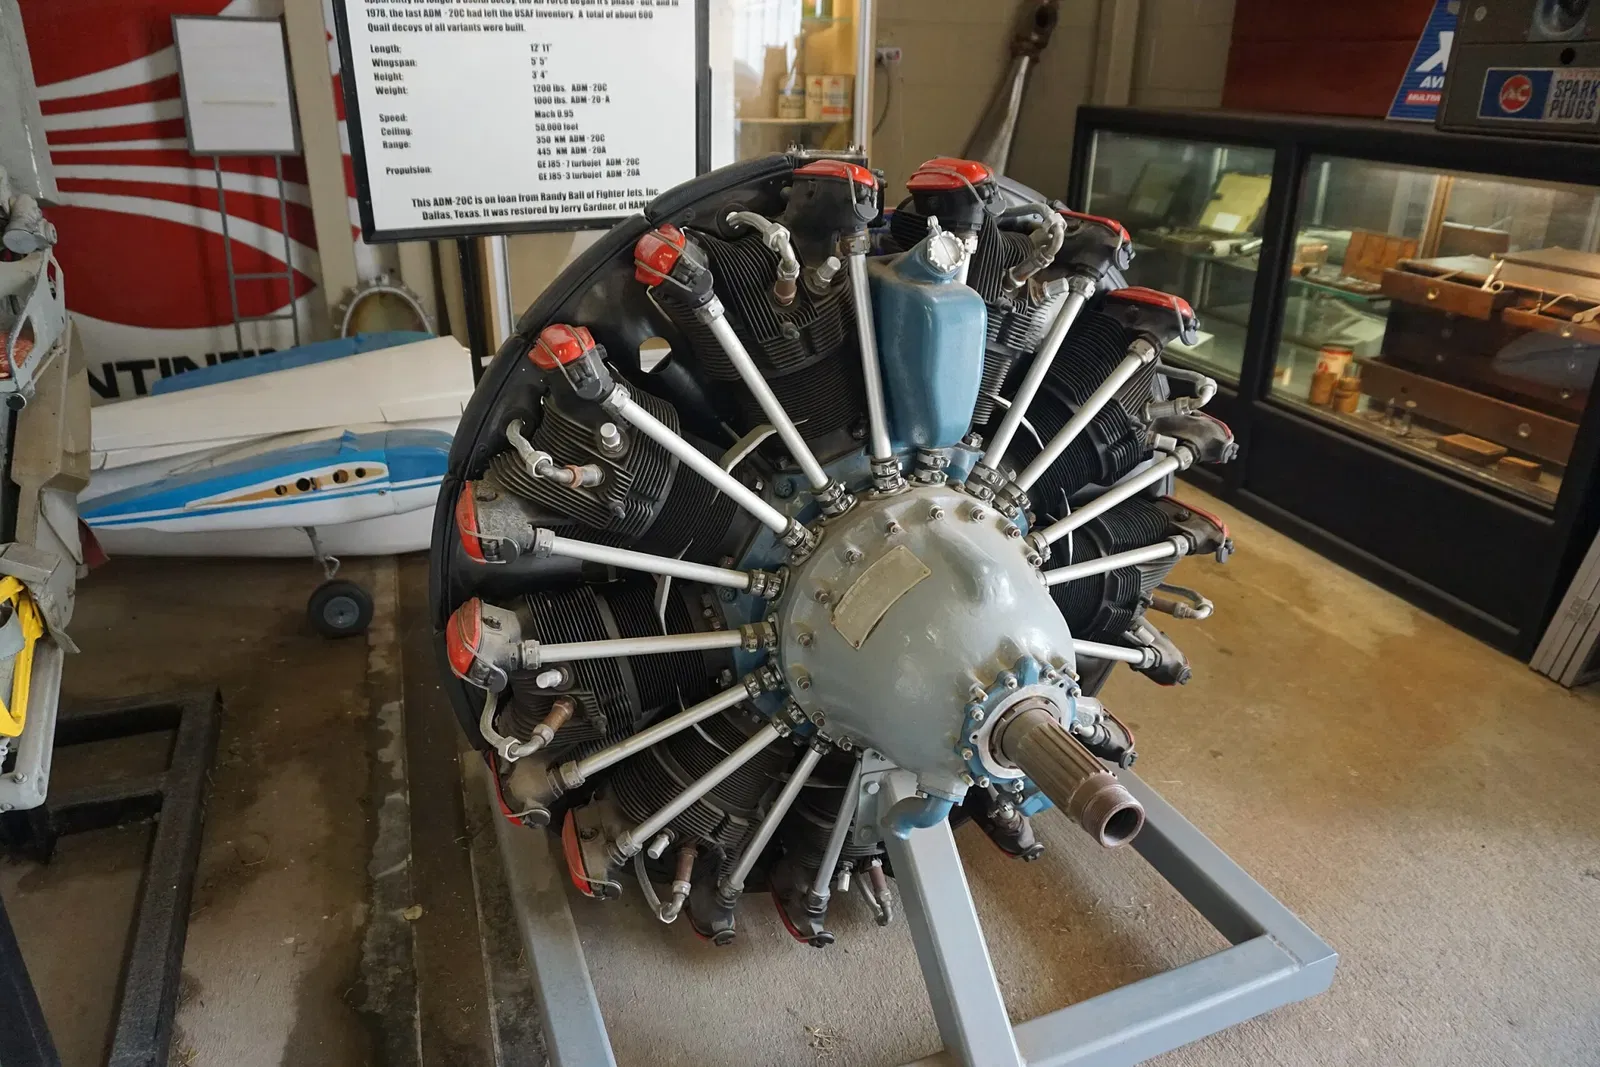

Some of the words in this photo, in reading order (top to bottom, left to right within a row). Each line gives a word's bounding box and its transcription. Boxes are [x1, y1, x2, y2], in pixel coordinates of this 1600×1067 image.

[389, 8, 404, 18] the
[404, 8, 422, 18] last
[466, 8, 482, 18] had
[484, 8, 498, 18] left
[499, 8, 513, 18] the
[514, 8, 534, 18] USAF
[578, 10, 584, 18] A
[586, 10, 604, 18] total
[606, 10, 613, 18] of
[615, 10, 637, 18] about
[638, 10, 653, 19] 600
[367, 22, 390, 32] Quail
[392, 22, 423, 32] decoys
[424, 22, 433, 32] of
[434, 22, 446, 32] all
[446, 22, 481, 32] variants
[482, 24, 504, 32] were
[505, 22, 526, 32] built.
[372, 58, 418, 68] Wingspan:
[373, 72, 404, 82] Height:
[374, 86, 409, 95] Weight:
[532, 83, 552, 93] 1200
[552, 84, 566, 92] lbs.
[1502, 84, 1530, 102] AC
[1554, 79, 1600, 99] SPARK
[533, 95, 553, 105] 1000
[553, 96, 568, 104] lbs.
[534, 109, 556, 118] Mach
[557, 109, 574, 118] 0.95
[1548, 99, 1596, 120] PLUGS
[379, 113, 408, 123] Speed:
[381, 127, 413, 136] Ceiling:
[563, 122, 579, 131] feet
[536, 135, 551, 144] 350
[554, 135, 566, 143] NM
[382, 140, 411, 150] Range:
[537, 147, 551, 155] 445
[556, 147, 568, 155] NM
[537, 160, 547, 168] GE
[571, 159, 601, 168] turbojet
[386, 165, 433, 175] Propulsion:
[538, 172, 548, 181] GE
[572, 170, 602, 179] turbojet
[411, 198, 431, 207] This
[433, 195, 473, 206] ADM-20C
[474, 195, 483, 204] is
[484, 196, 496, 204] on
[497, 194, 517, 203] loan
[518, 192, 539, 202] from
[540, 191, 566, 201] Randy
[568, 190, 585, 200] Ball
[586, 190, 595, 199] of
[596, 188, 625, 199] Fighter
[422, 211, 453, 220] Dallas,
[454, 209, 481, 219] Texas.
[483, 208, 490, 217] It
[491, 207, 509, 216] was
[510, 205, 548, 216] restored
[549, 204, 559, 214] by
[560, 204, 581, 213] Jerry
[619, 201, 627, 210] of
